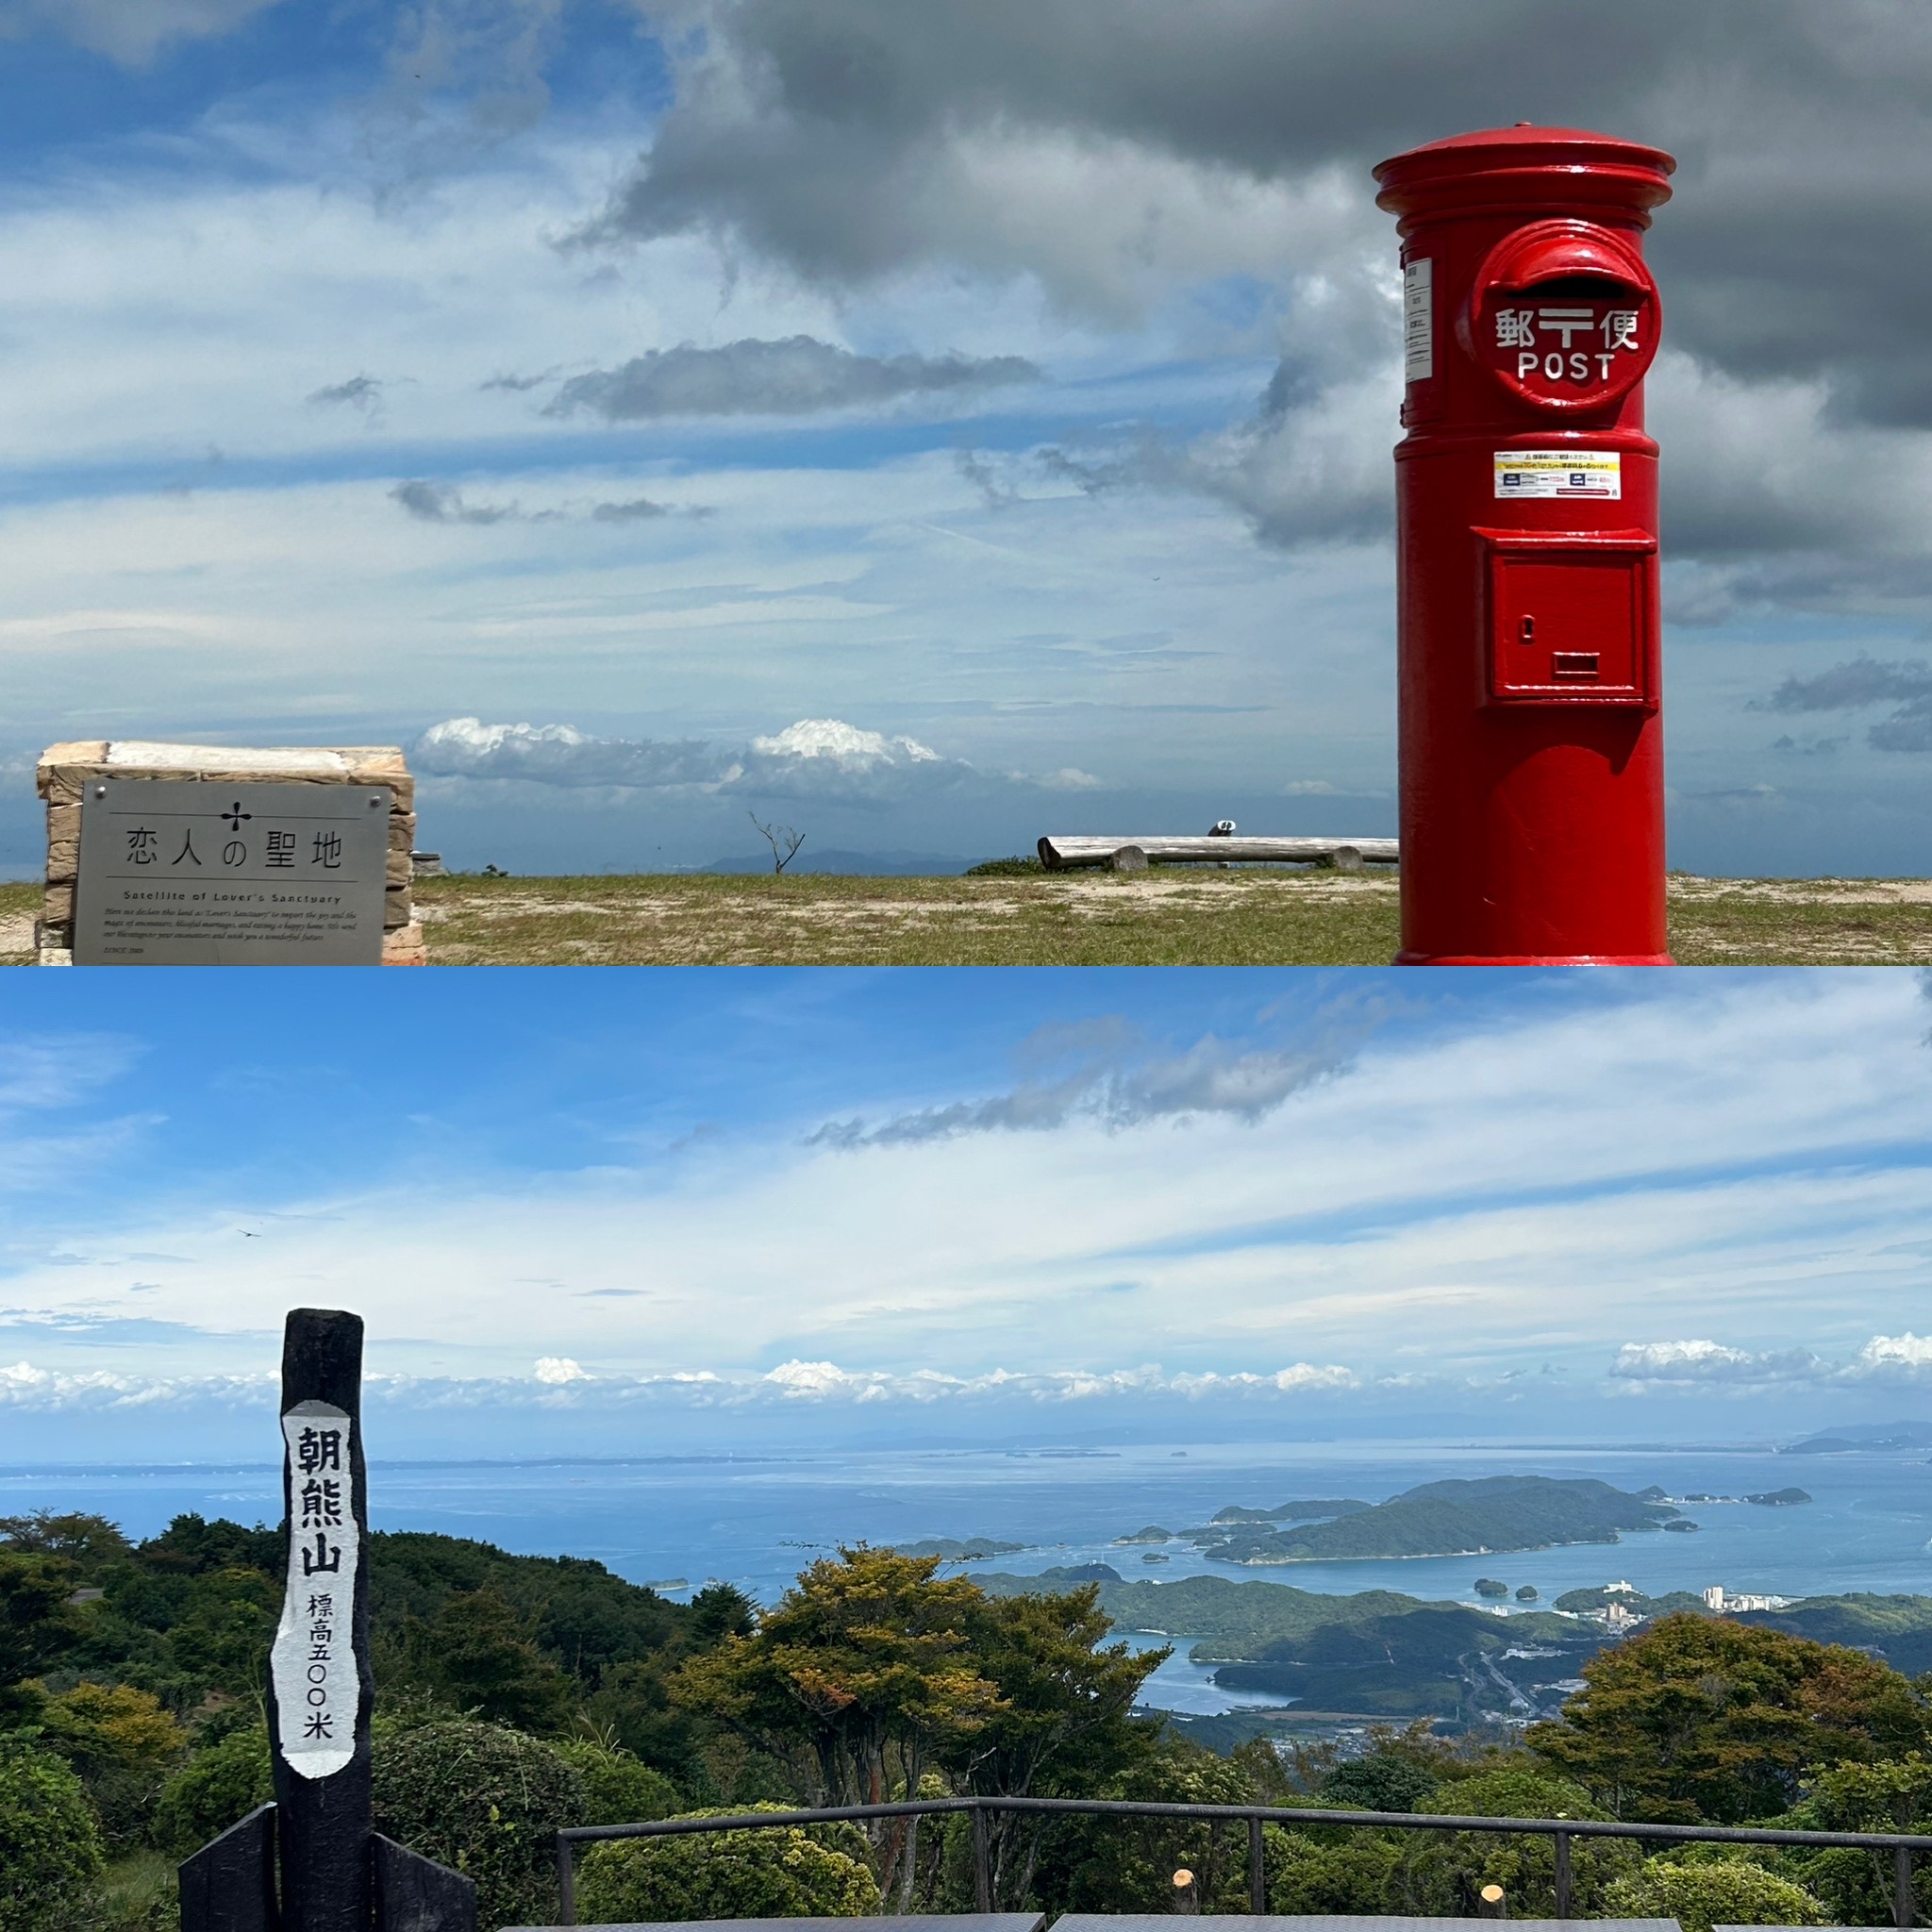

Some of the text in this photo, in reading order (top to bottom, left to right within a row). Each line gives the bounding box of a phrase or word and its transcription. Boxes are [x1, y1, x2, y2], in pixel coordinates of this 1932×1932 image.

[1518, 353, 1615, 380] POST
[126, 826, 342, 869] 恋人の聖地
[124, 891, 186, 901] Satellite
[192, 892, 207, 901] of
[272, 893, 341, 905] Sanctuary
[298, 1426, 341, 1576] 朝熊山
